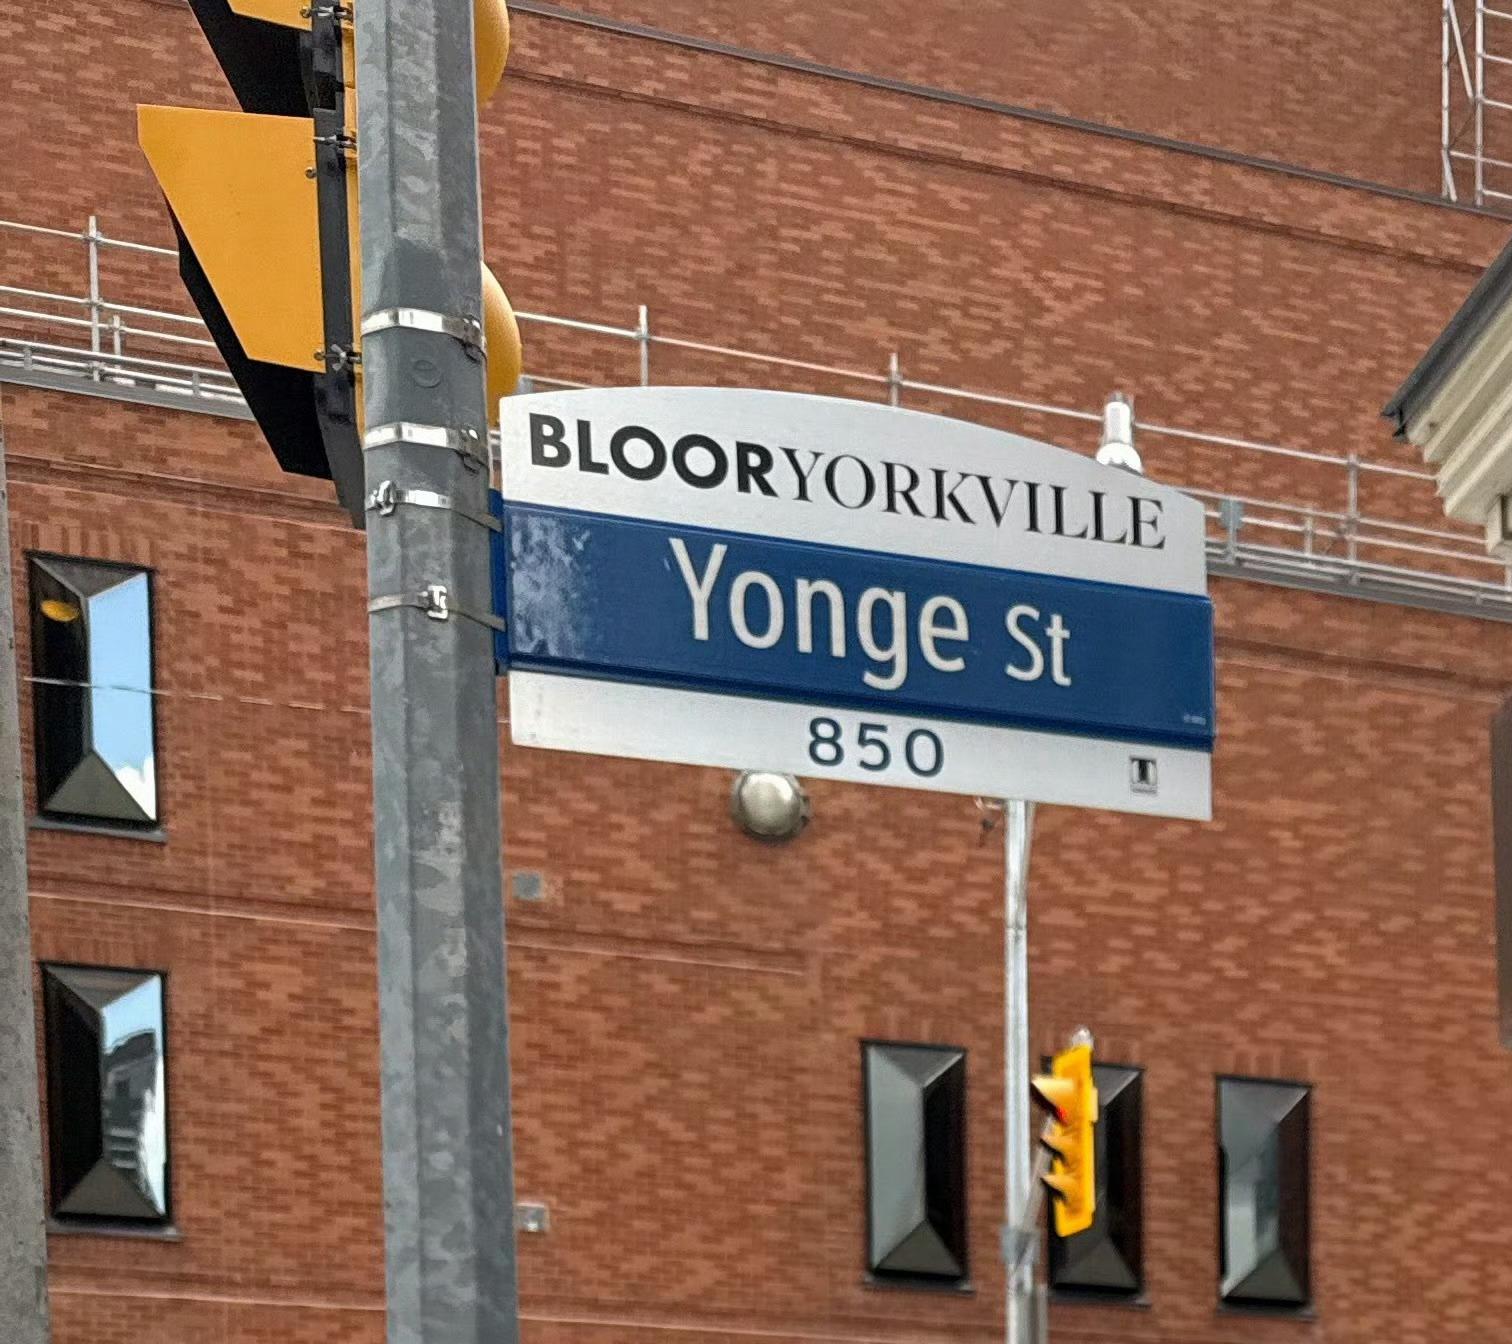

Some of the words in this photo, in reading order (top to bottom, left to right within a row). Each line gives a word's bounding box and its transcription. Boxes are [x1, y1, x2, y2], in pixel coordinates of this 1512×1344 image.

[669, 537, 970, 691] Yonge
[1005, 603, 1073, 688] St
[808, 716, 945, 778] 850
